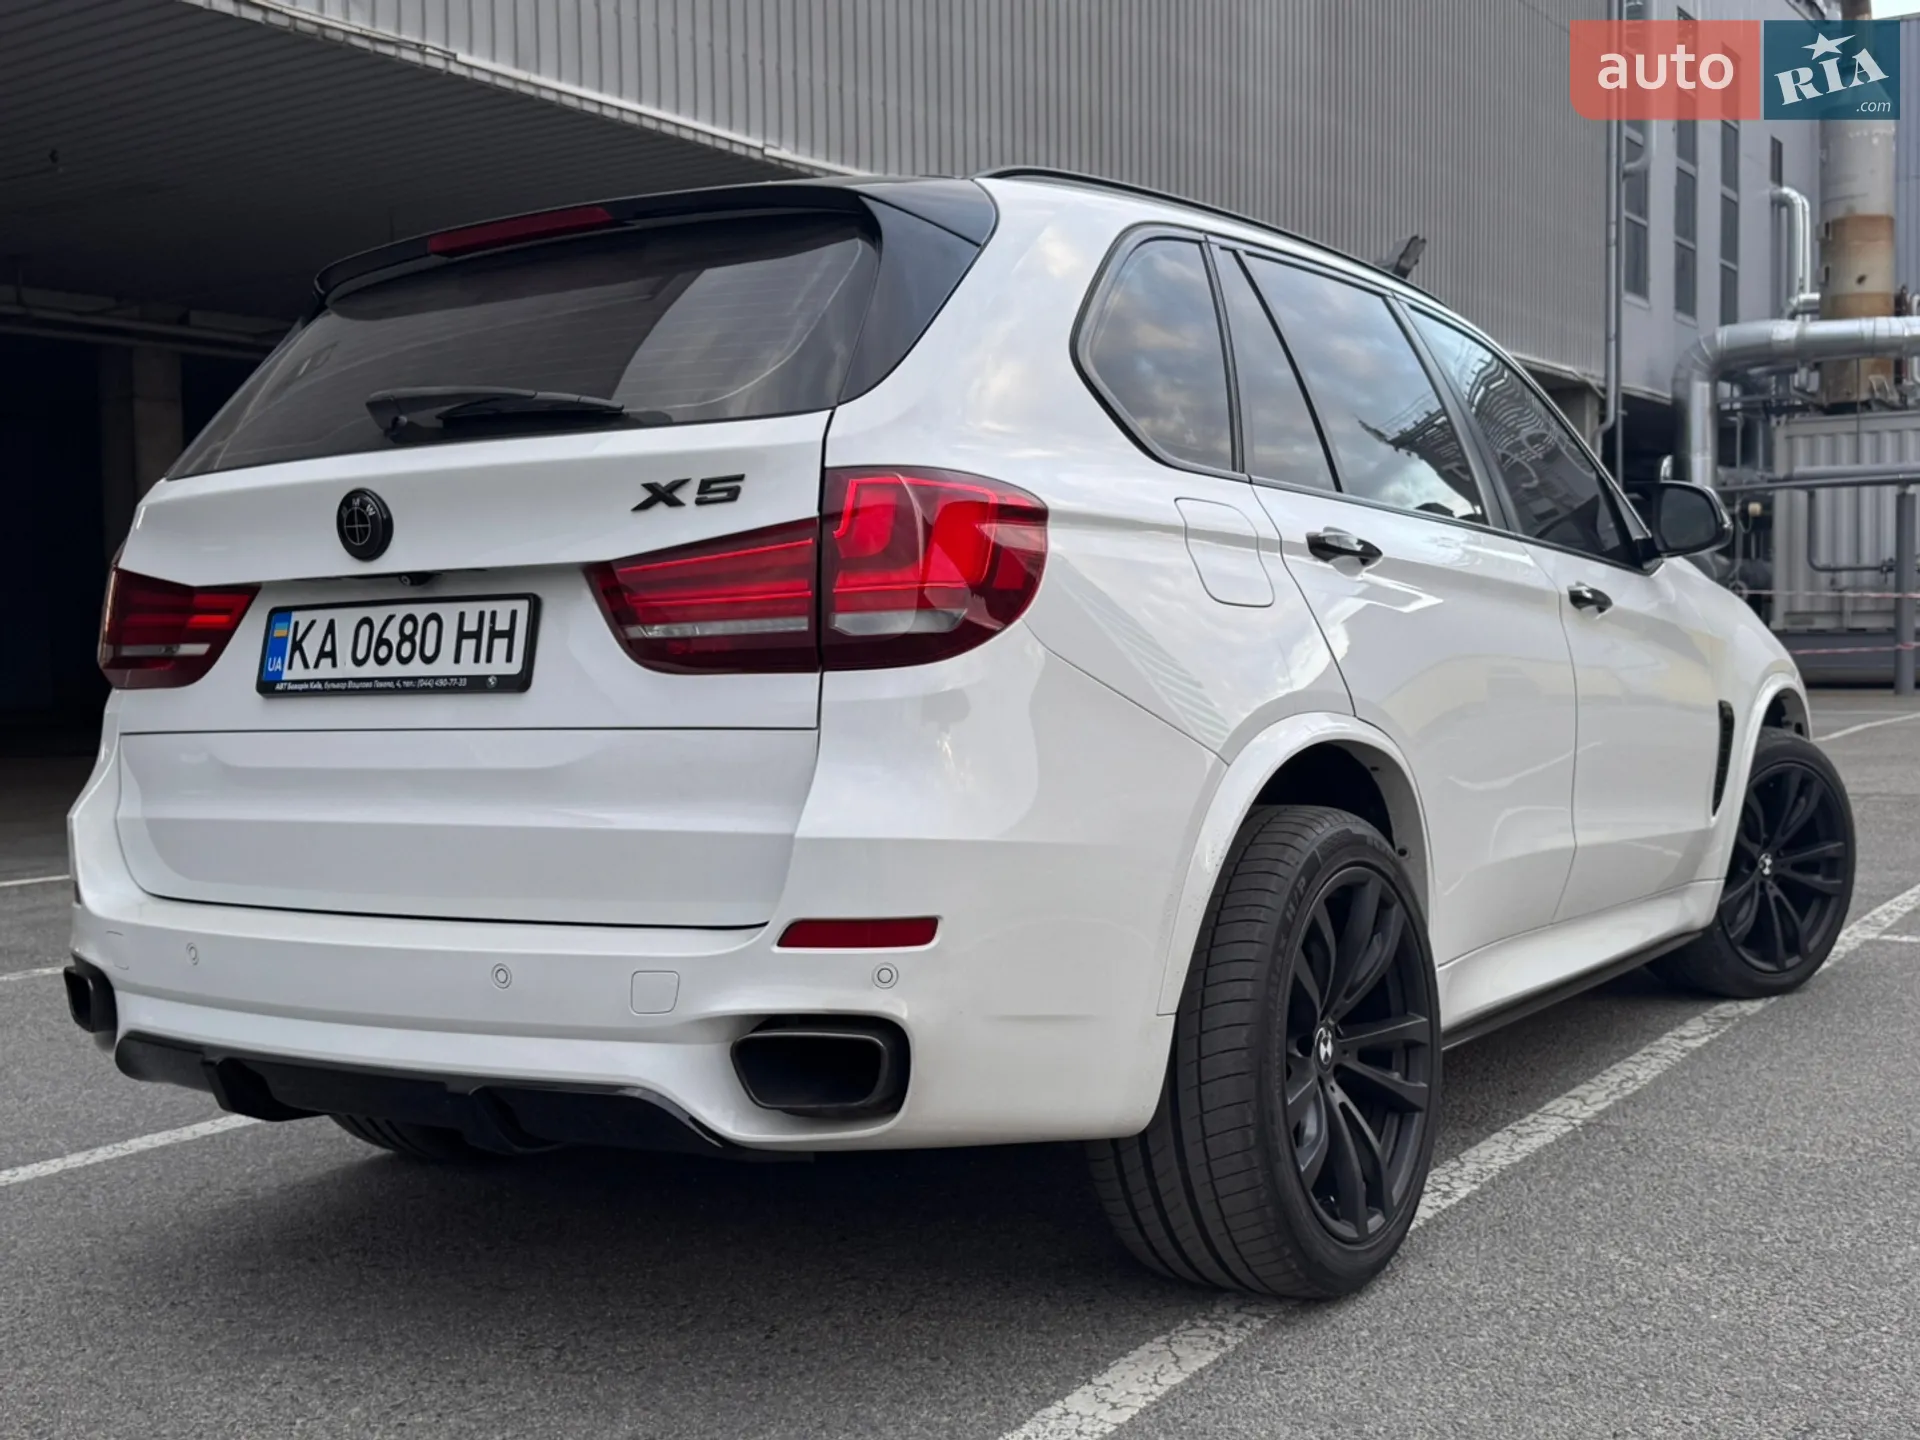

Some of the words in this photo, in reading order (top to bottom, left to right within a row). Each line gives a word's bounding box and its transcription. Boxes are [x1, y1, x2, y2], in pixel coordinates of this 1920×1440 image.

[630, 473, 746, 511] X5
[287, 618, 338, 670] KA
[351, 612, 443, 667] 0680
[453, 609, 518, 664] HH
[268, 656, 282, 672] UA
